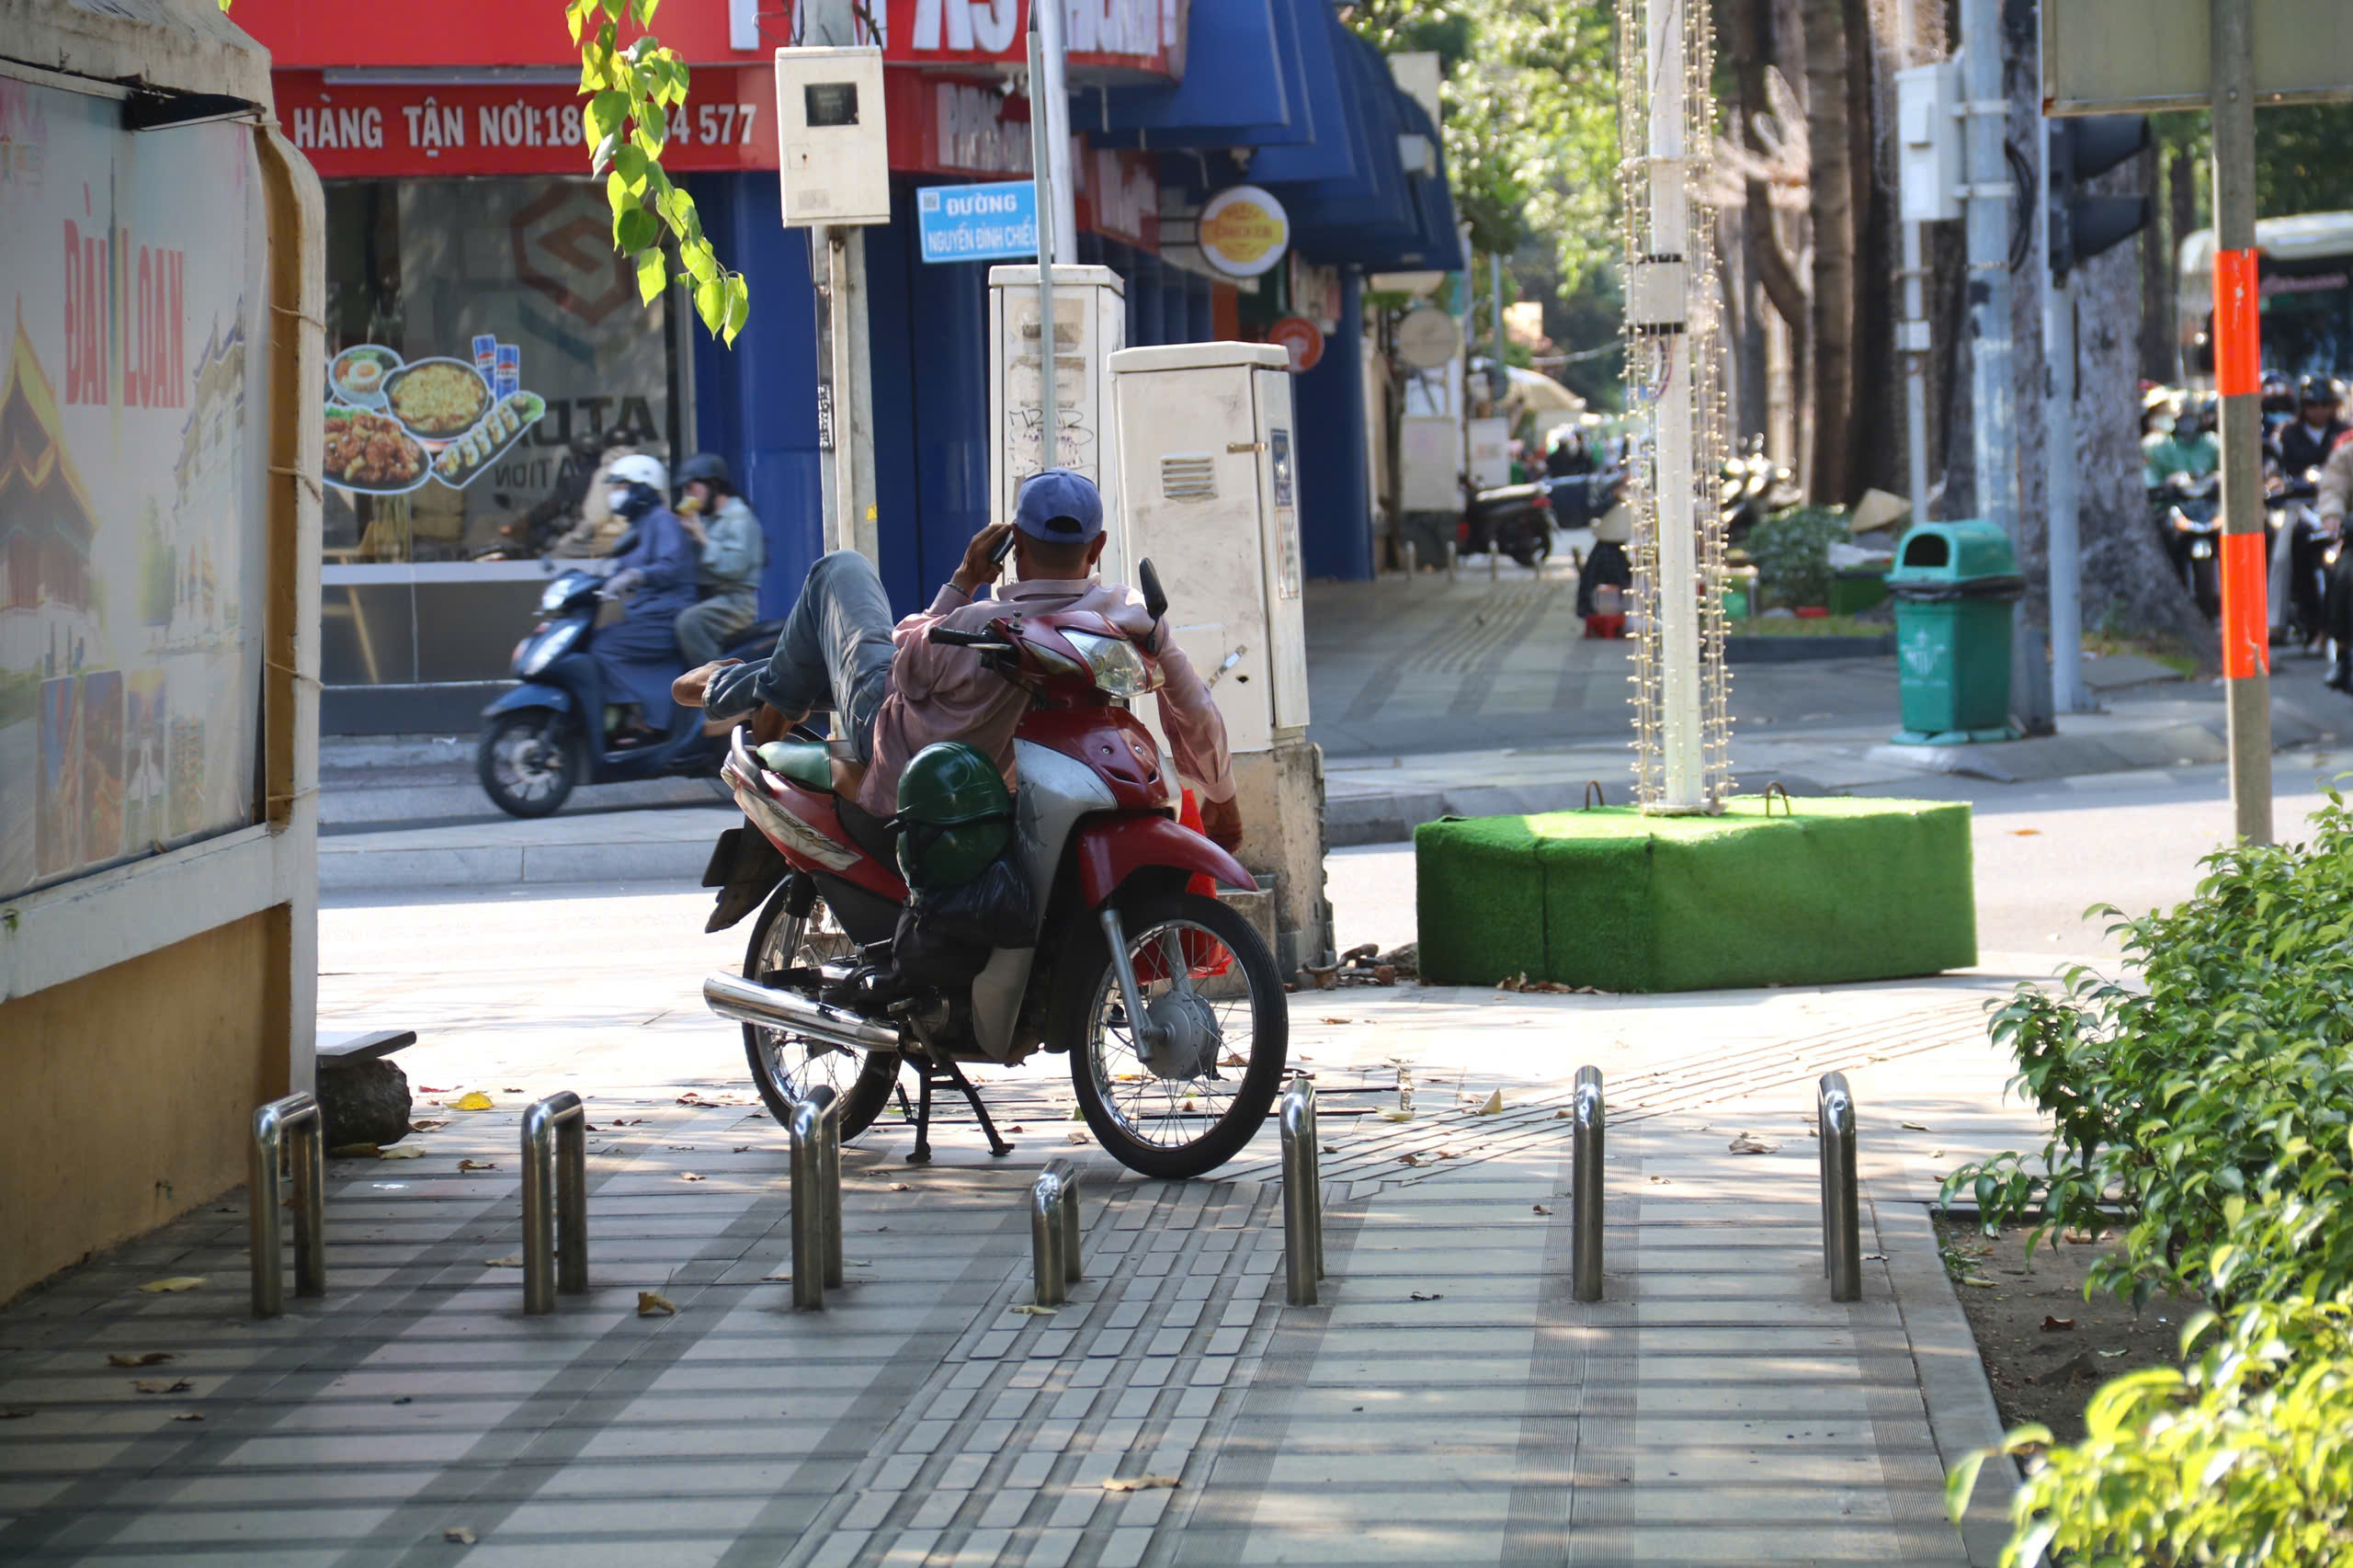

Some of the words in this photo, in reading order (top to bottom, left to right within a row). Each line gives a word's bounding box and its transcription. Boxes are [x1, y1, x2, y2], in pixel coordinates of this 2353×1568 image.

[293, 93, 383, 148] HÀNG
[402, 96, 464, 157] TẬN
[699, 103, 757, 145] 577
[946, 191, 1017, 217] ĐƯỜNG
[63, 180, 108, 405] ĐÀI
[121, 227, 187, 409] LOAN
